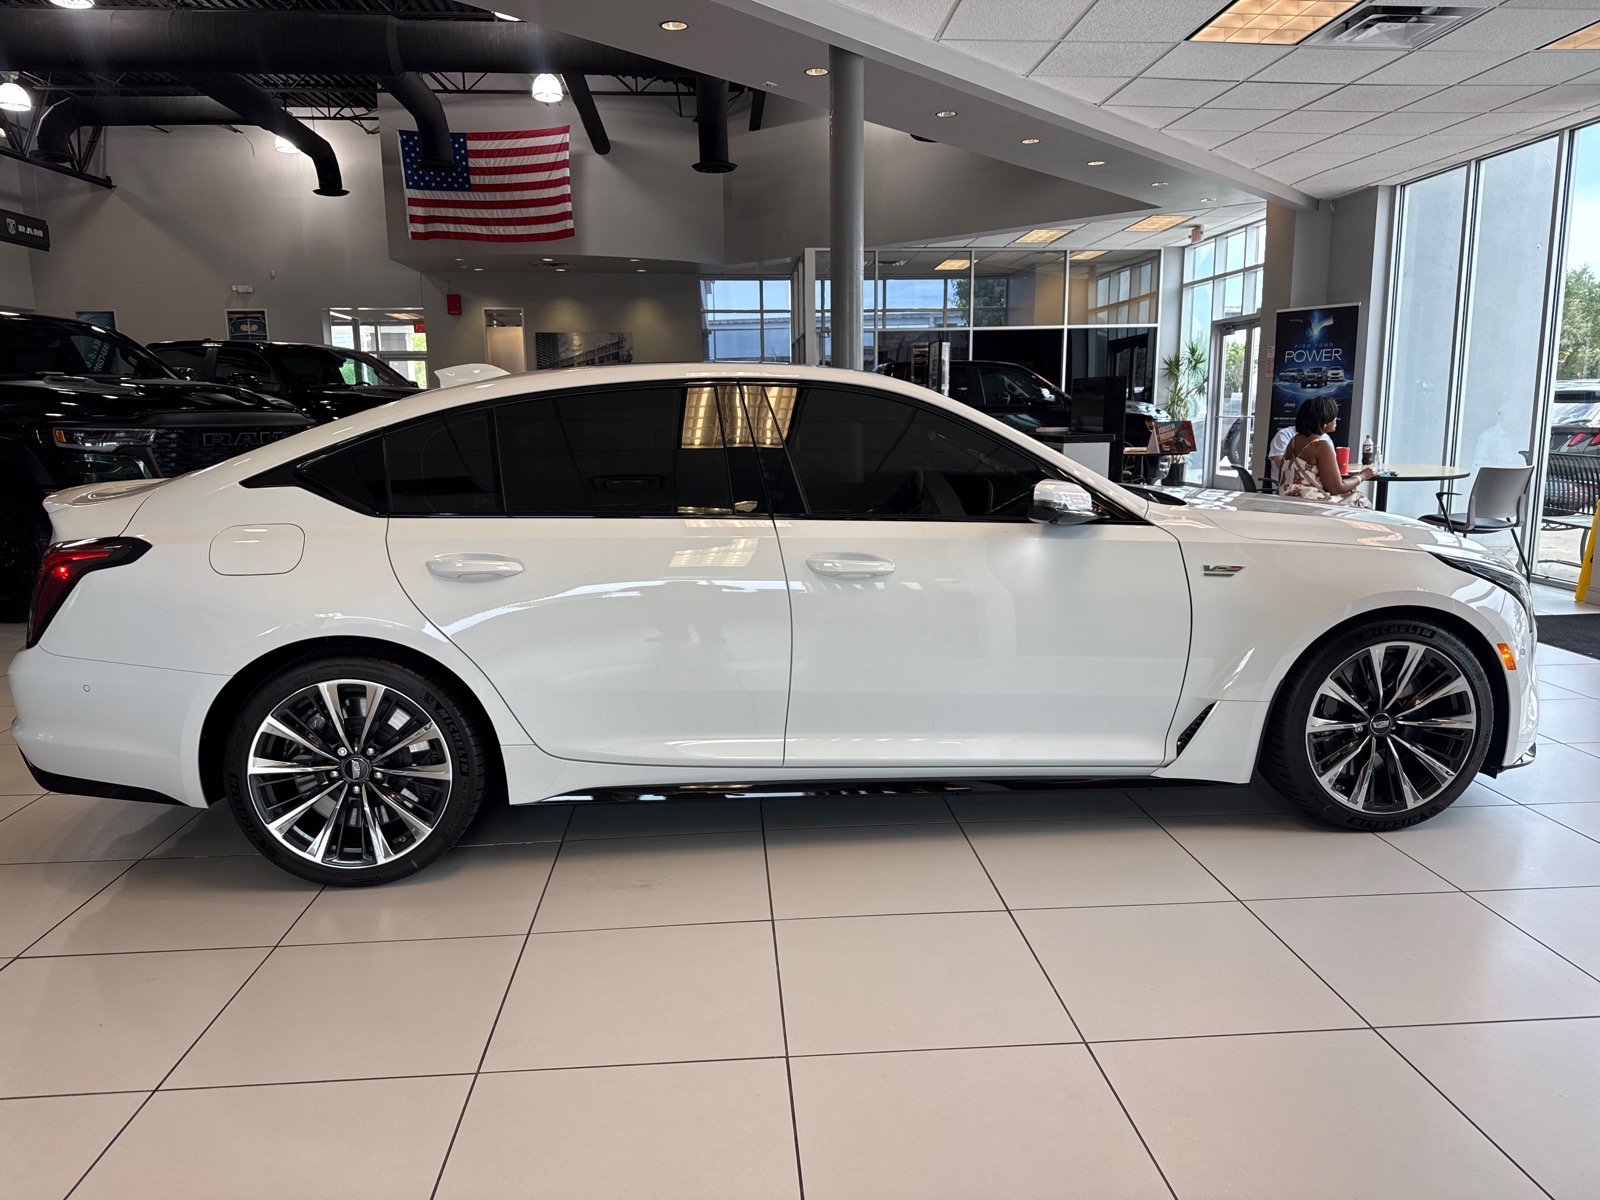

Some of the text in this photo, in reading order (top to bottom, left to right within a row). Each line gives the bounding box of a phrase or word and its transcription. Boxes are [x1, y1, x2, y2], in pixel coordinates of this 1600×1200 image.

[17, 224, 44, 238] RAM
[1284, 348, 1343, 363] POWER
[203, 431, 287, 447] RAM
[1362, 624, 1436, 640] MICHELIN
[437, 707, 469, 777] MICHELIN
